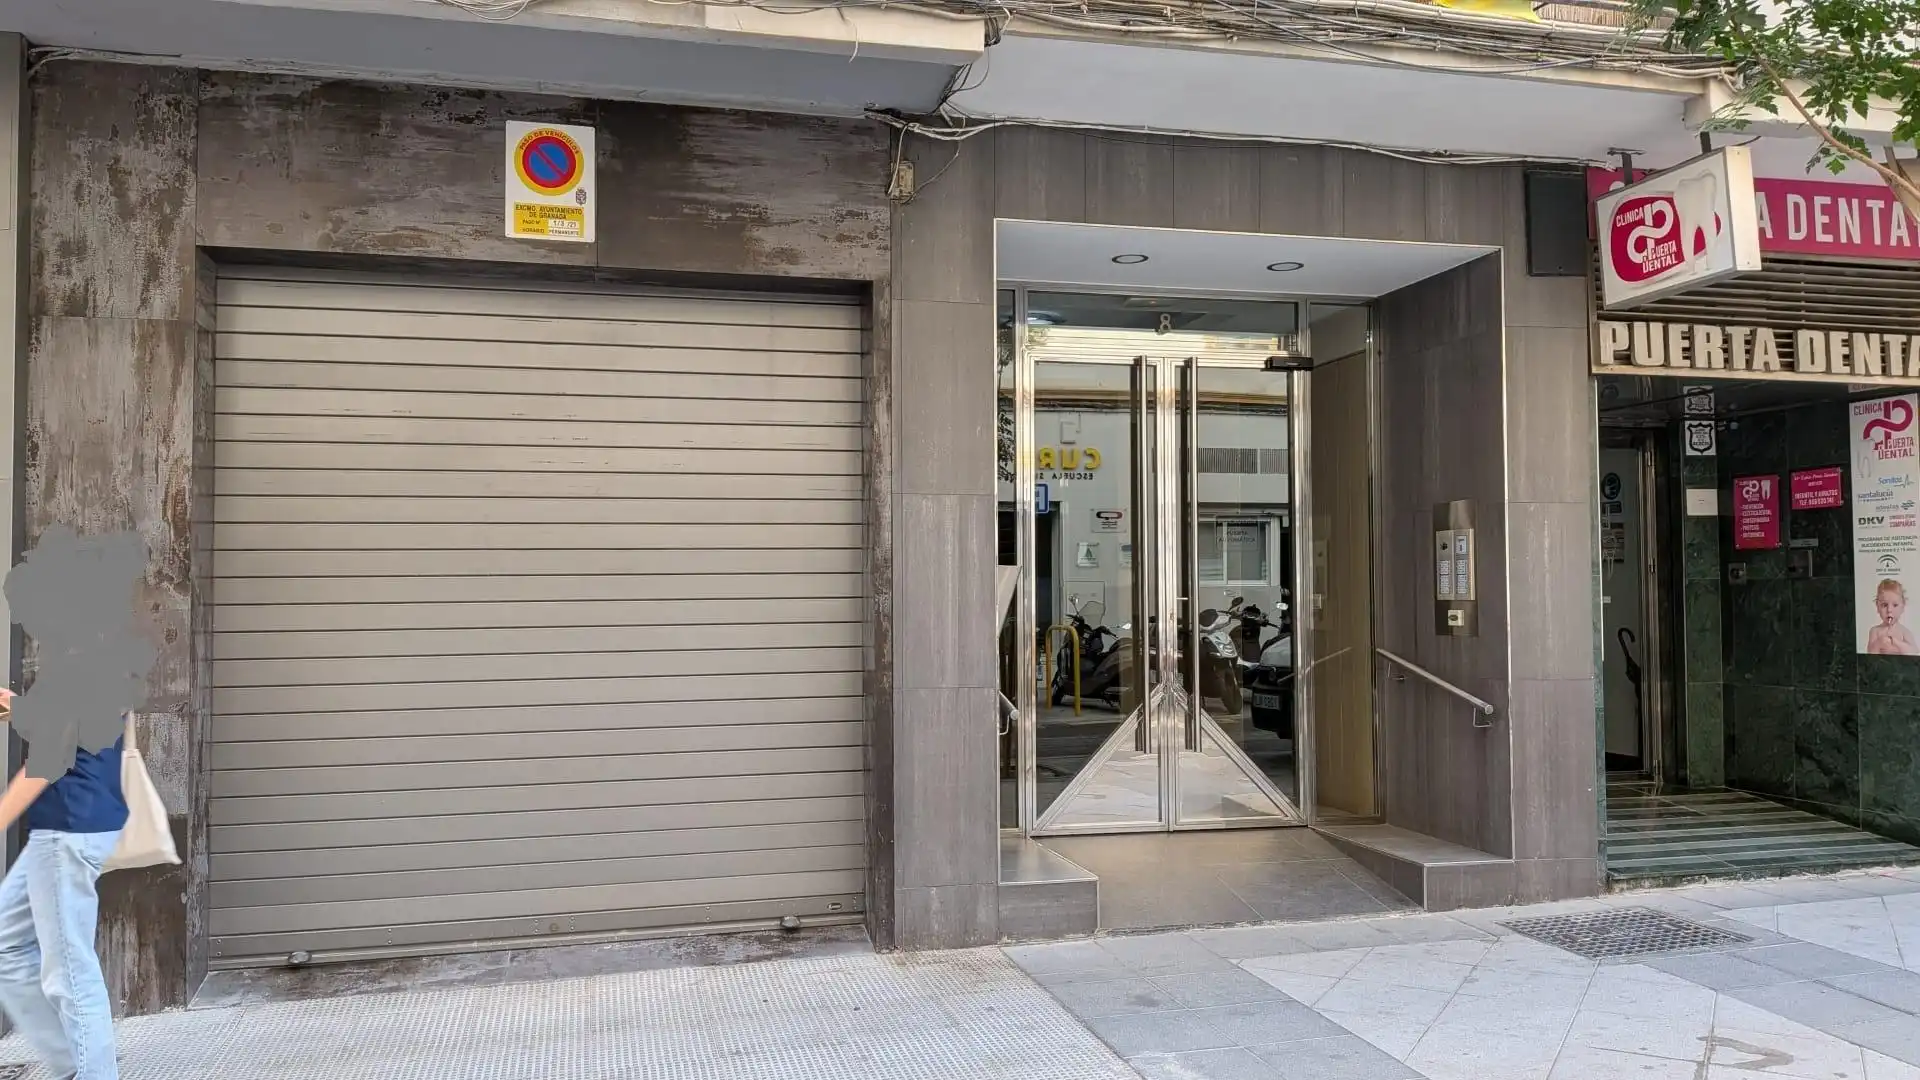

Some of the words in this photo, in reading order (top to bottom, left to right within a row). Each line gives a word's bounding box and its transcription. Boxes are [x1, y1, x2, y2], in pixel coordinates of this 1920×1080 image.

[520, 131, 534, 150] PASO
[539, 206, 582, 215] AYUNTAMIENTO
[539, 212, 567, 220] GRANADA
[1160, 313, 1171, 333] 8
[1599, 320, 1781, 372] PUERTA
[1858, 516, 1884, 525] DKV
